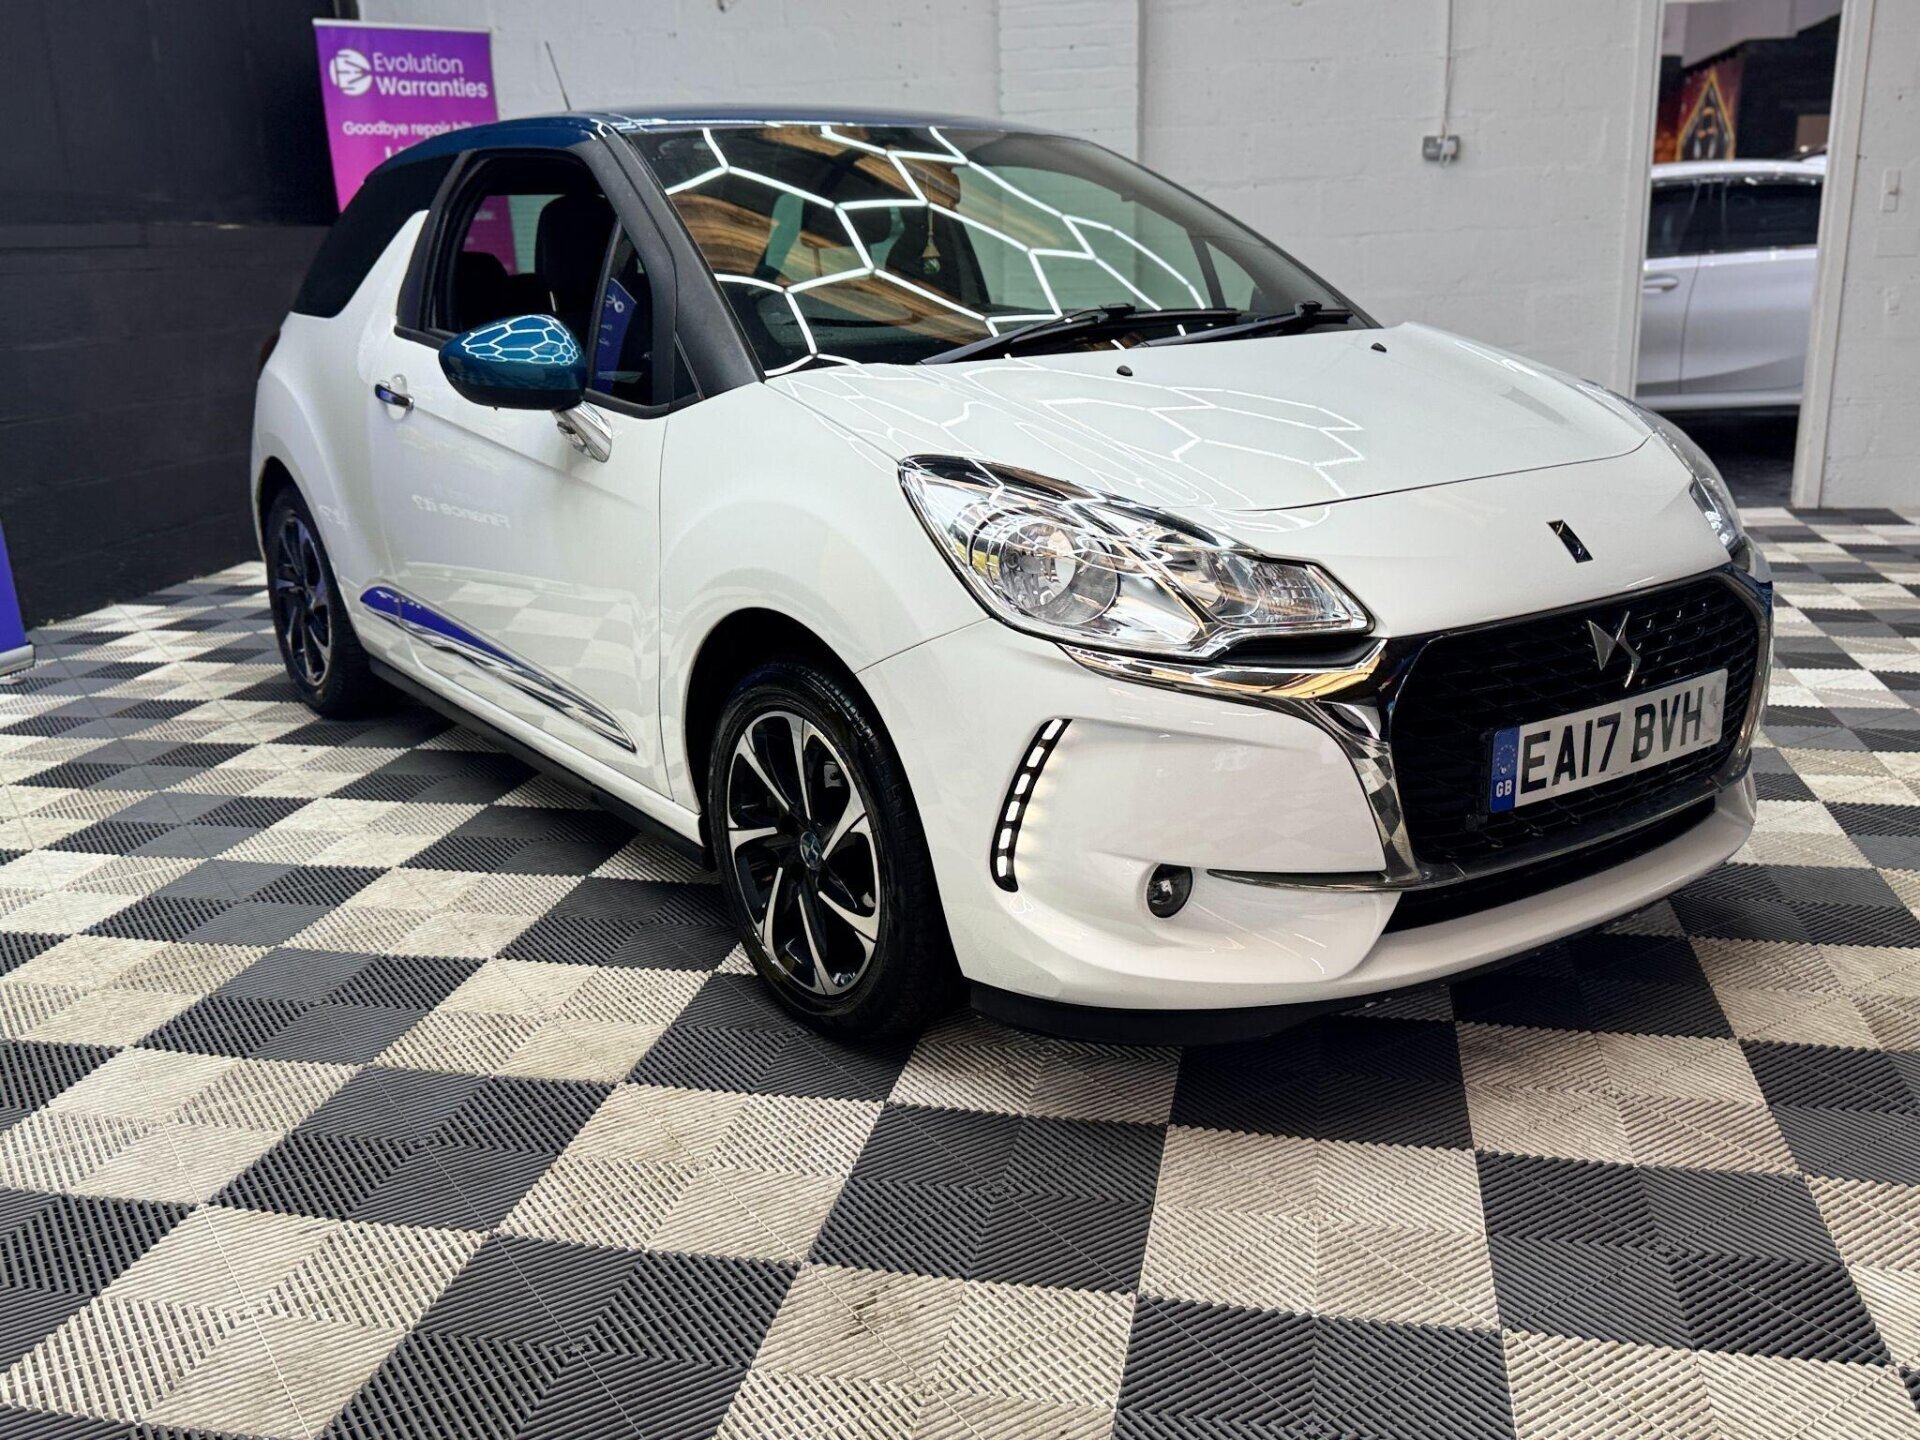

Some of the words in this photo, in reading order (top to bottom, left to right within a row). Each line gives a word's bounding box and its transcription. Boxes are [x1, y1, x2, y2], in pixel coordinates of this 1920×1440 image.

[373, 52, 463, 74] Evolution
[375, 77, 489, 99] Warranties
[342, 121, 409, 138] Goodbye
[1520, 712, 1621, 794] EA17
[1630, 686, 1704, 763] BVH
[1495, 779, 1513, 798] GB
